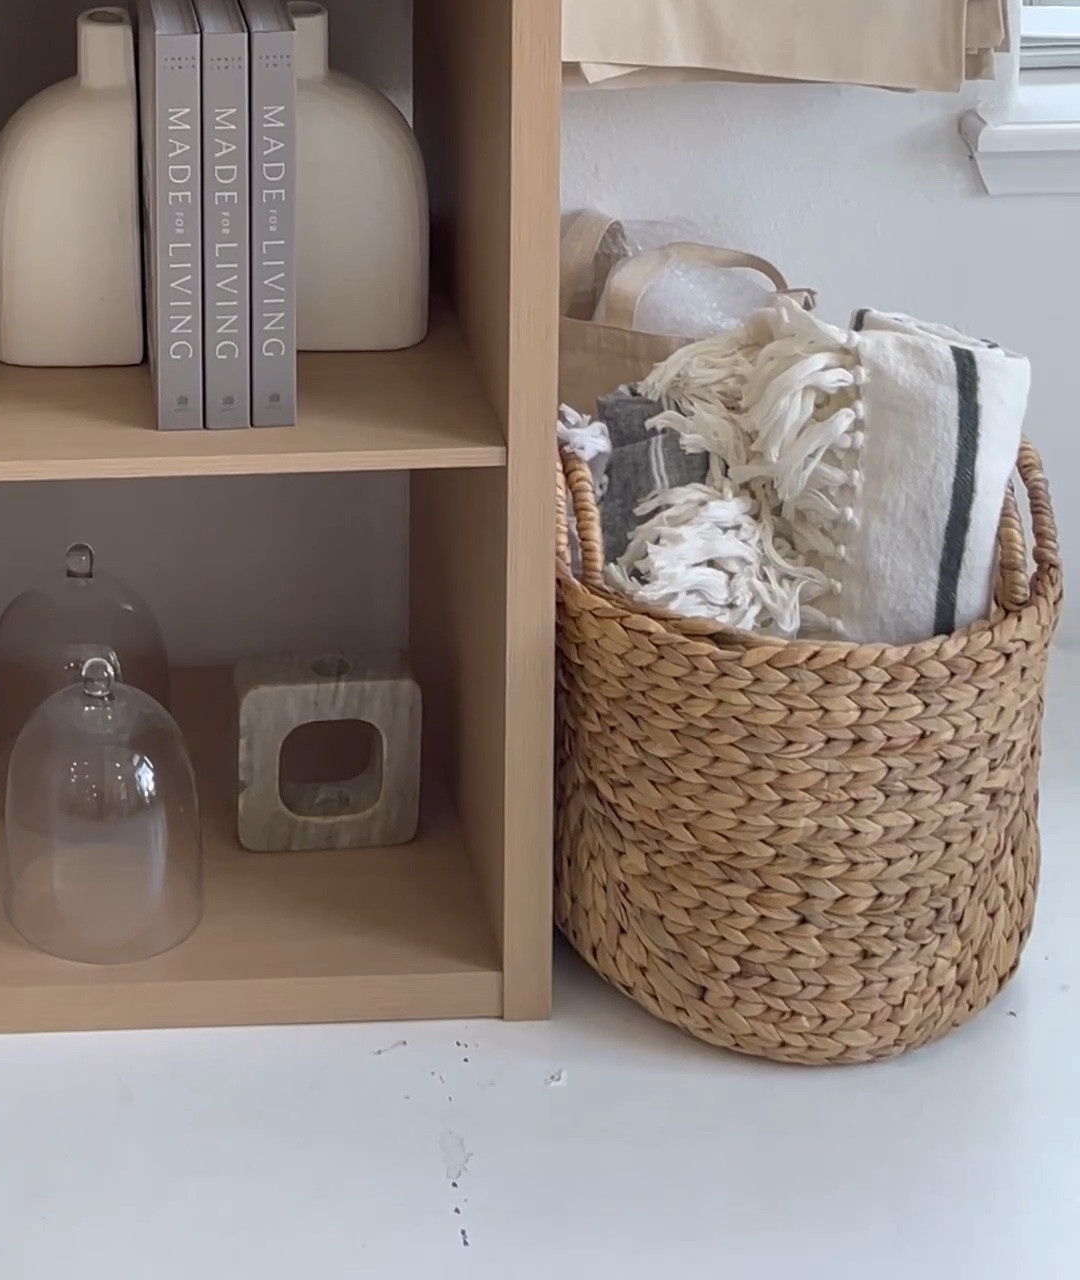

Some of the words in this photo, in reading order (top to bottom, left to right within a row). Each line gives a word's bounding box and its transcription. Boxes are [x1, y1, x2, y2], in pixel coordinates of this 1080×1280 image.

[168, 108, 191, 206] MADE
[214, 108, 238, 206] MADE
[262, 105, 286, 203] MADE
[174, 211, 185, 235] FOR
[220, 211, 231, 235] FOR
[268, 209, 278, 232] FOR
[168, 242, 193, 359] LIVING
[215, 242, 239, 359] LIVING
[262, 240, 286, 357] LIVING
